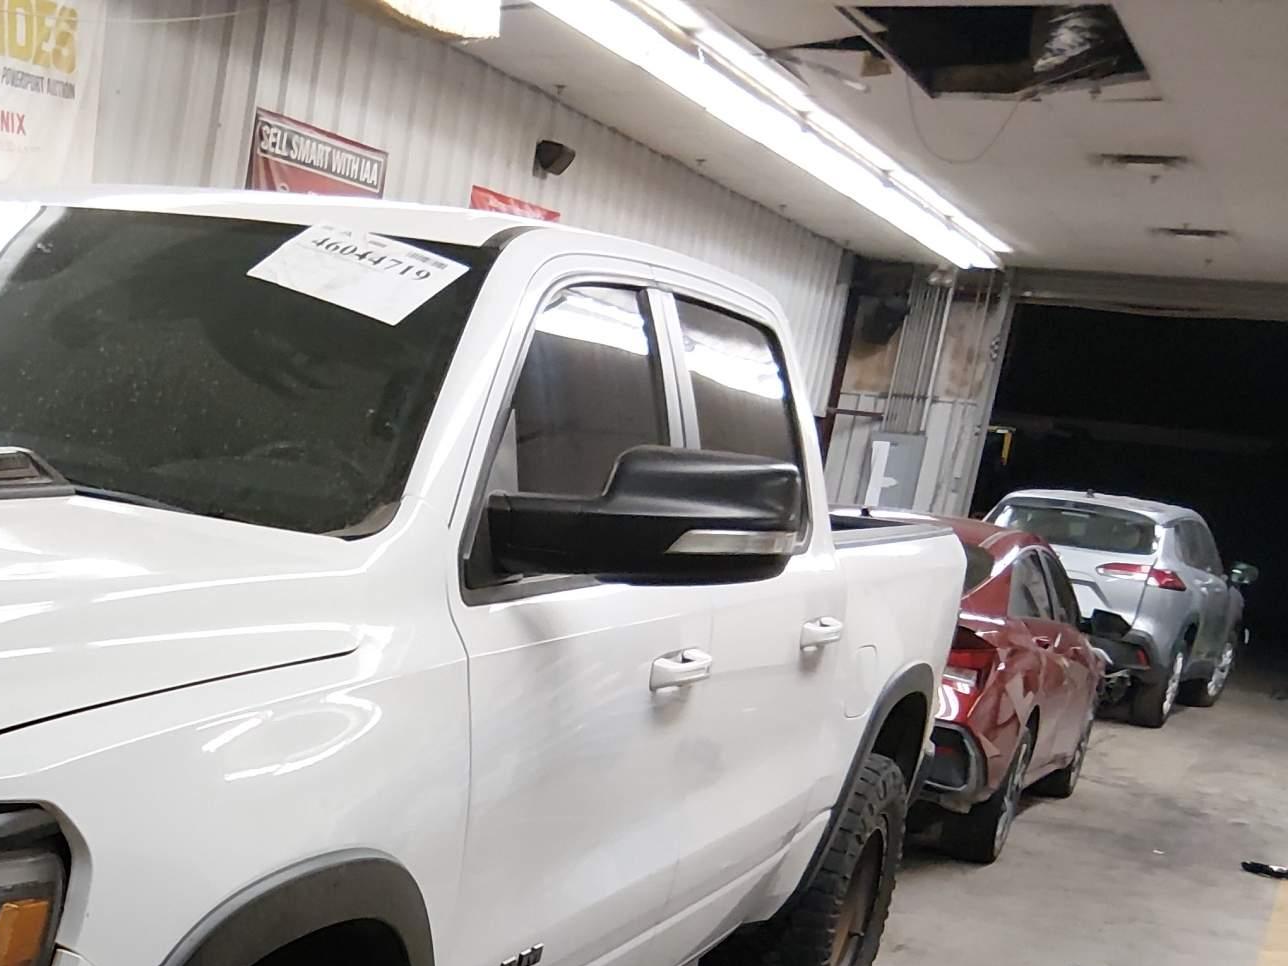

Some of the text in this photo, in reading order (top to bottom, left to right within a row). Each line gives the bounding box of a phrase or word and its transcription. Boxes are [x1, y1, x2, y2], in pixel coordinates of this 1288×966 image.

[261, 124, 379, 186] SELL SMART WITH IAA
[312, 236, 431, 281] 46044719
